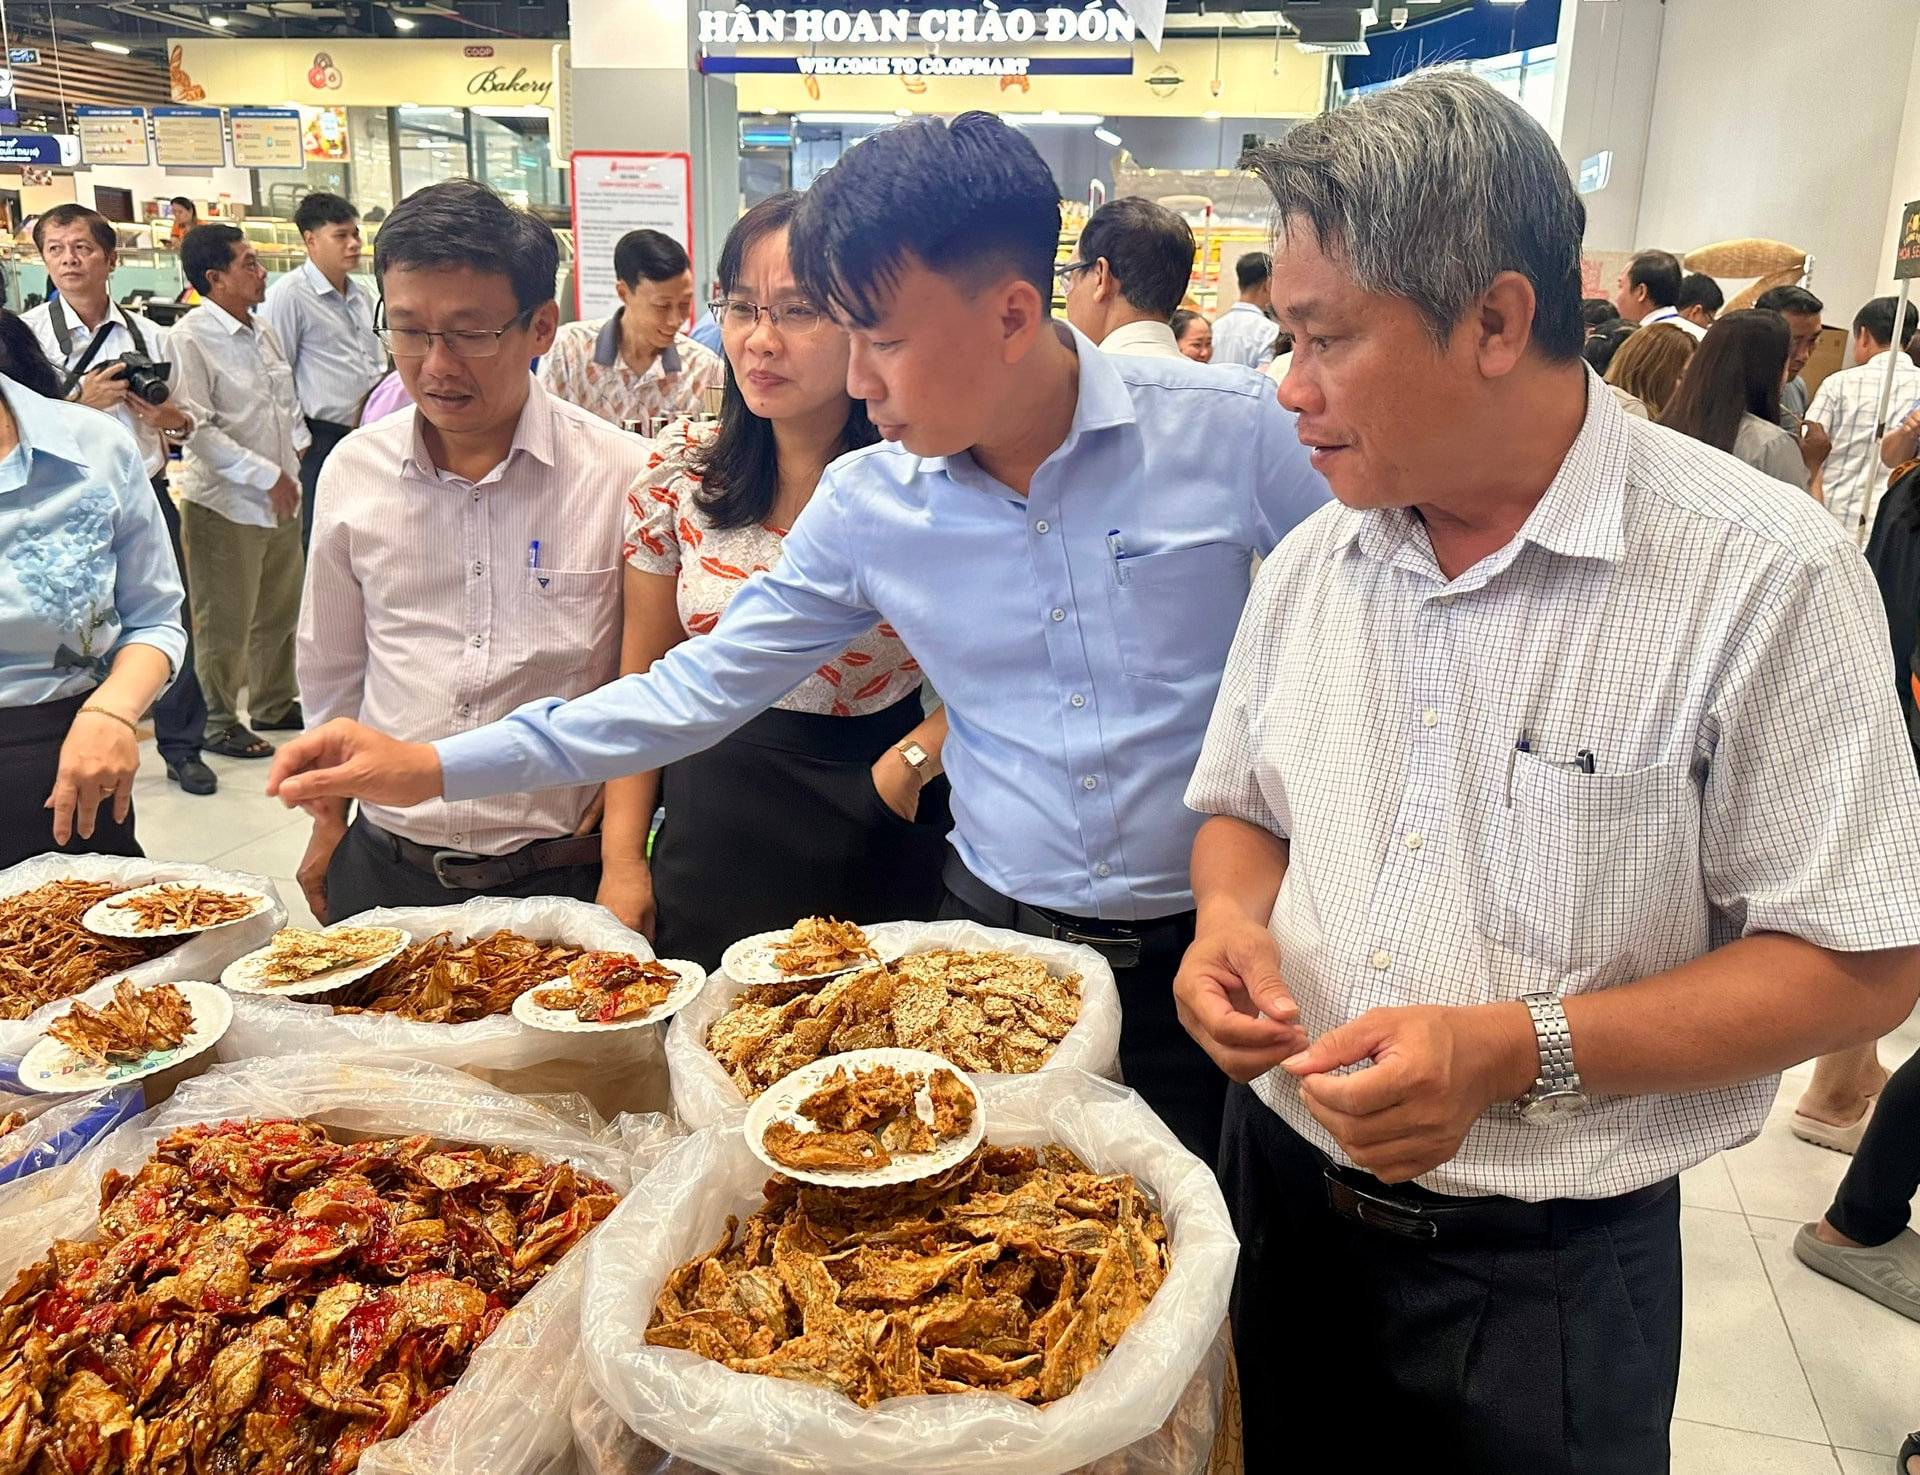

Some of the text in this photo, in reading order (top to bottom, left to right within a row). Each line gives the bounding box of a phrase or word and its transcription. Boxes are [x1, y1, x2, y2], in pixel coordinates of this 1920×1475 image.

[698, 0, 1136, 42] HÂN HOAN CHÀO ĐÓN
[467, 66, 553, 105] Bakery
[796, 57, 1031, 75] WELCOME TO CO.OPMART
